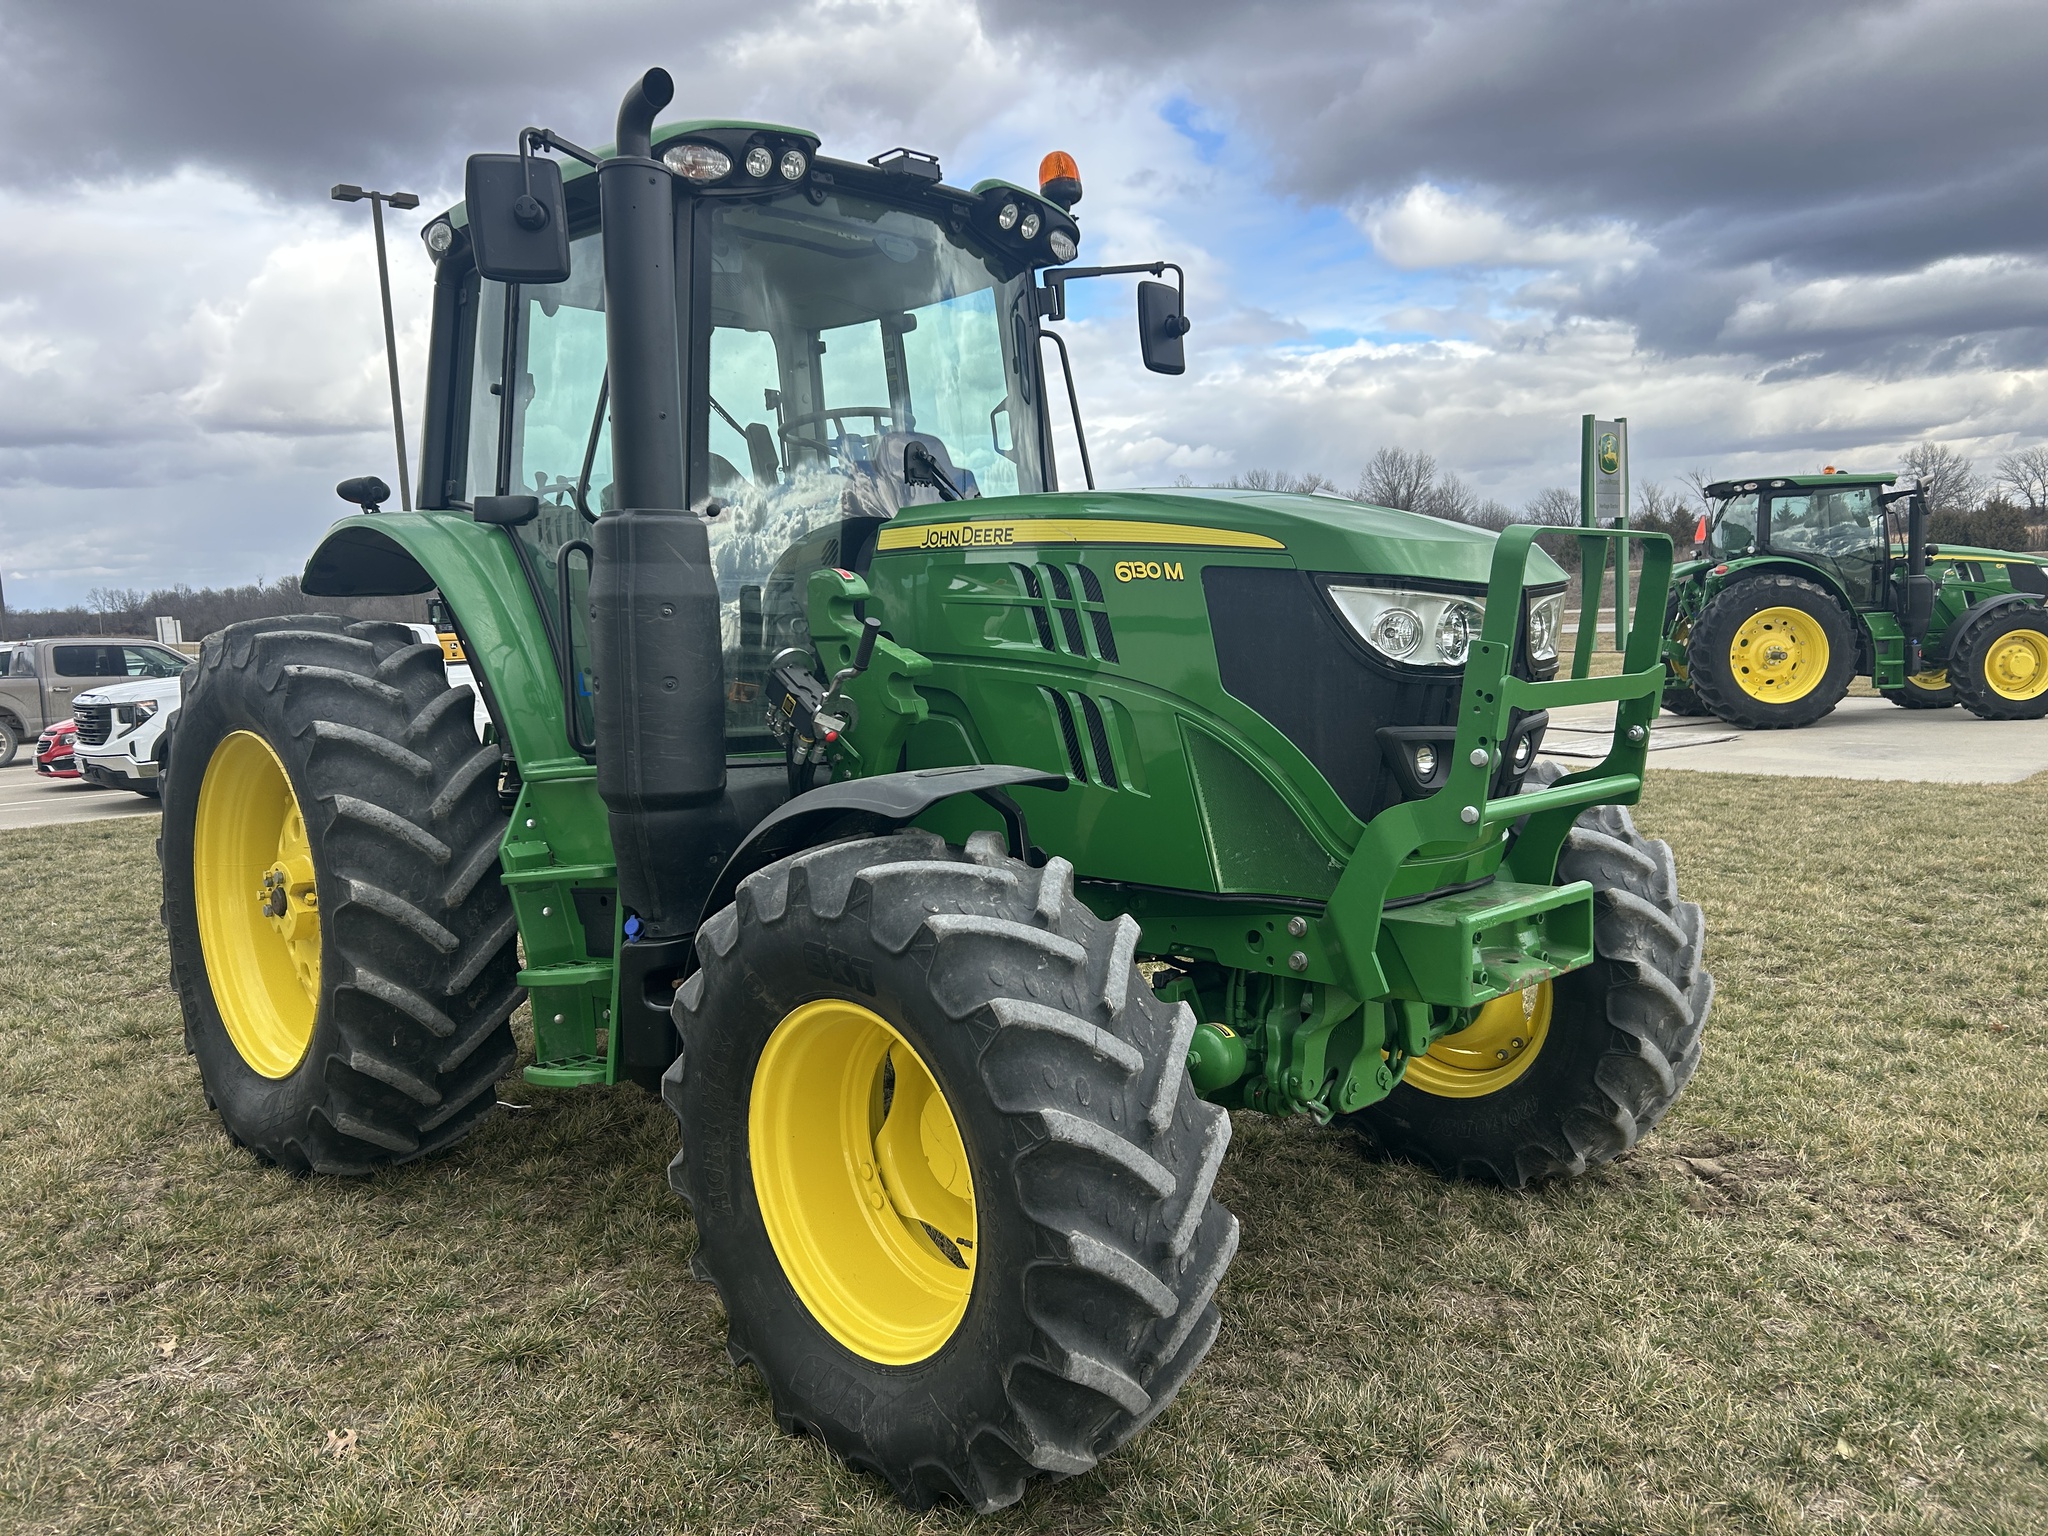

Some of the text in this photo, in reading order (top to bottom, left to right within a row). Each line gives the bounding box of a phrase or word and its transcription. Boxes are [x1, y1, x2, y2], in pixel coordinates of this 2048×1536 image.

[921, 525, 1015, 547] JOHN DEERE
[1114, 561, 1184, 583] 6130 M
[802, 940, 878, 998] BKT
